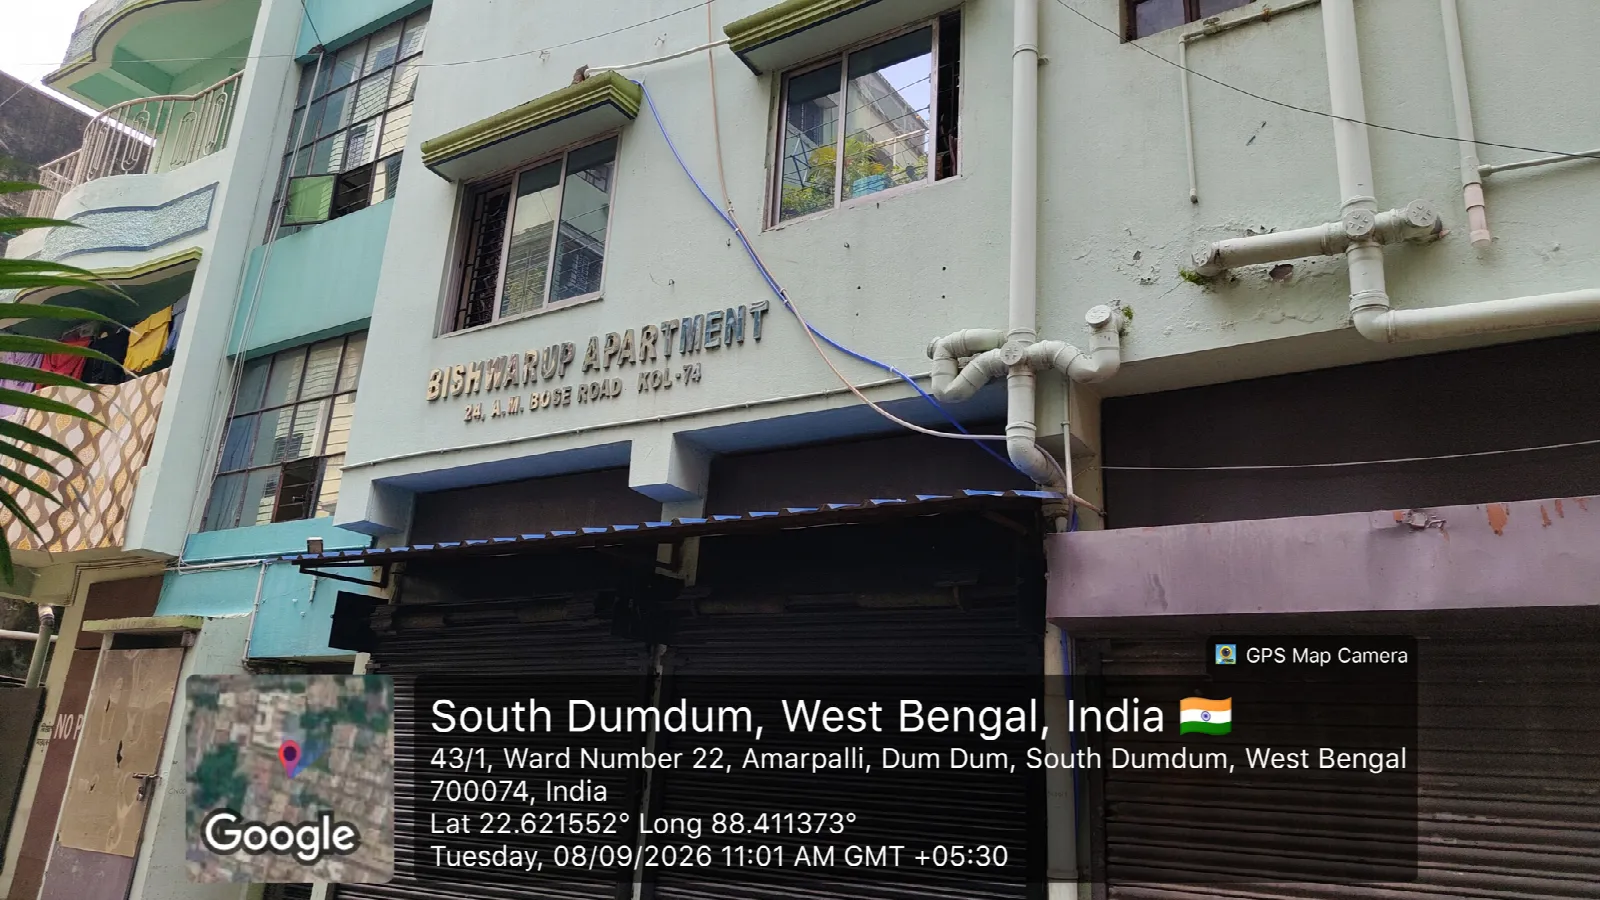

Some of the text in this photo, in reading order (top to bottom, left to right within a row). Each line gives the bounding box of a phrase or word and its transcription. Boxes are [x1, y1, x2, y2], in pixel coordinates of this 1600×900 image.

[427, 300, 769, 401] BISHWARUP APARTMENT
[529, 385, 572, 411] BOSE
[578, 377, 623, 403] ROAD
[637, 362, 702, 394] KOL-74
[53, 713, 74, 740] NO
